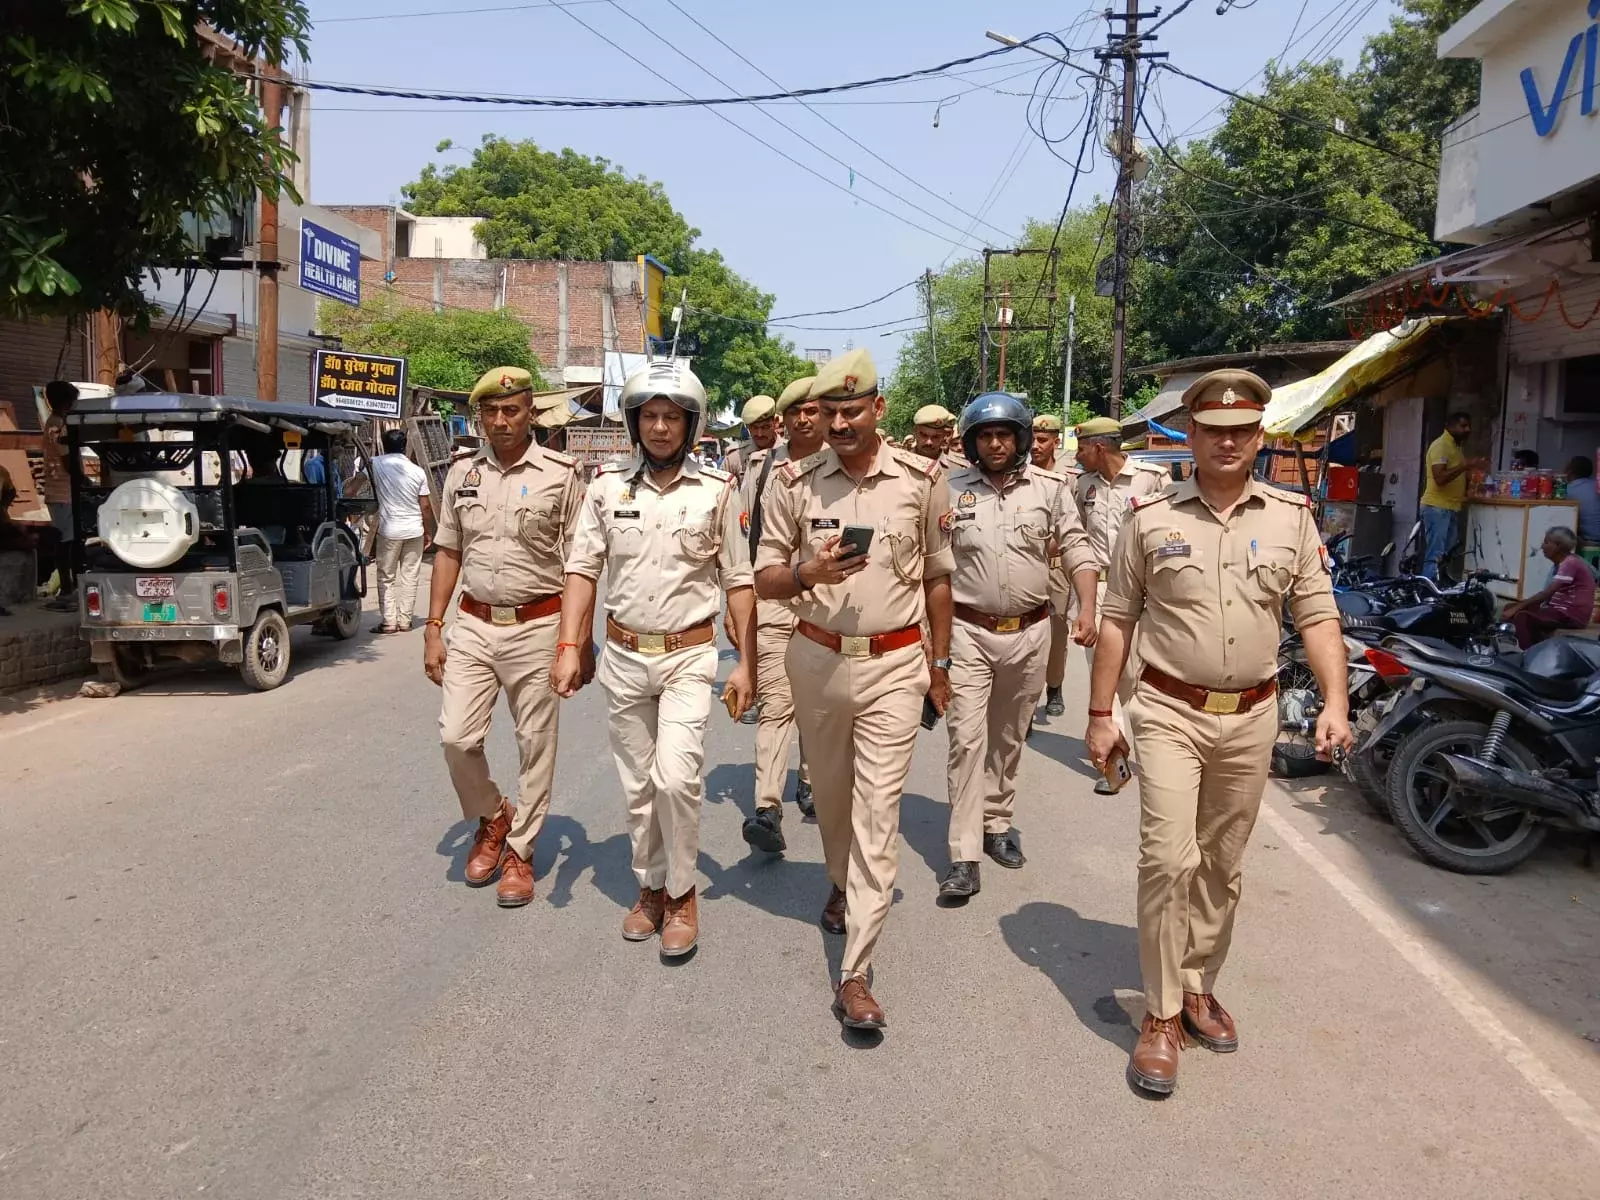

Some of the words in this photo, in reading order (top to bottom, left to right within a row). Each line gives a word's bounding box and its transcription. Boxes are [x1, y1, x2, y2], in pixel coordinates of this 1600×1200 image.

[314, 238, 351, 272] DIVINE
[304, 261, 336, 287] HEALTH
[336, 274, 357, 295] CARE
[344, 357, 368, 375] सुरेश
[370, 362, 396, 378] गुप्ता
[340, 379, 363, 392] रजत
[365, 379, 398, 396] गोयल
